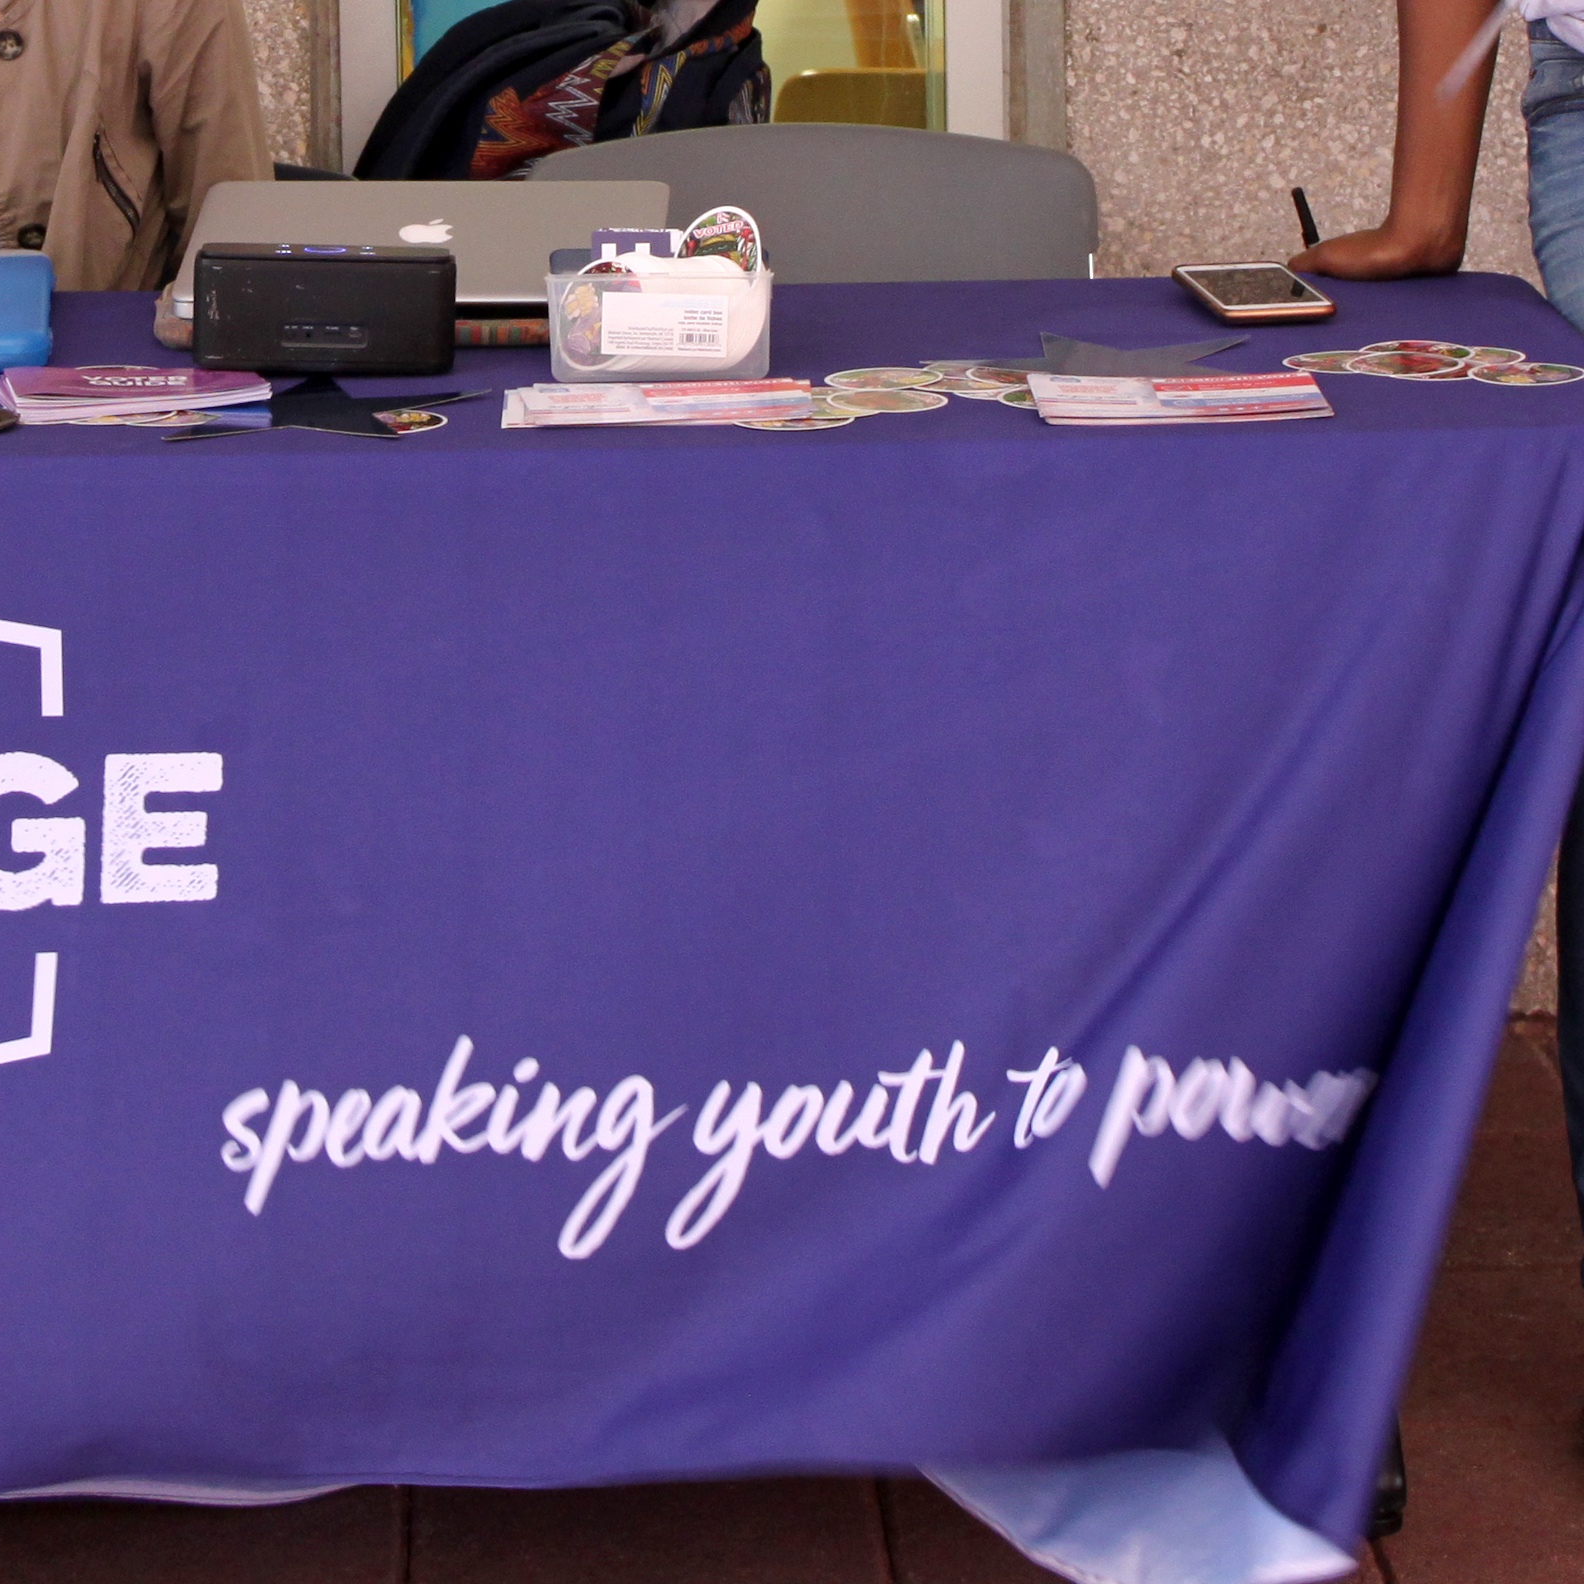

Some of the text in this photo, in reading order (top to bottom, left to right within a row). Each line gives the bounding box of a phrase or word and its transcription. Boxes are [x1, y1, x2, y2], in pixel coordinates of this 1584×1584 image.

[693, 221, 744, 239] VOTED
[219, 1034, 688, 1260] speaking
[664, 1039, 997, 1250] youth
[1007, 1045, 1088, 1151] to
